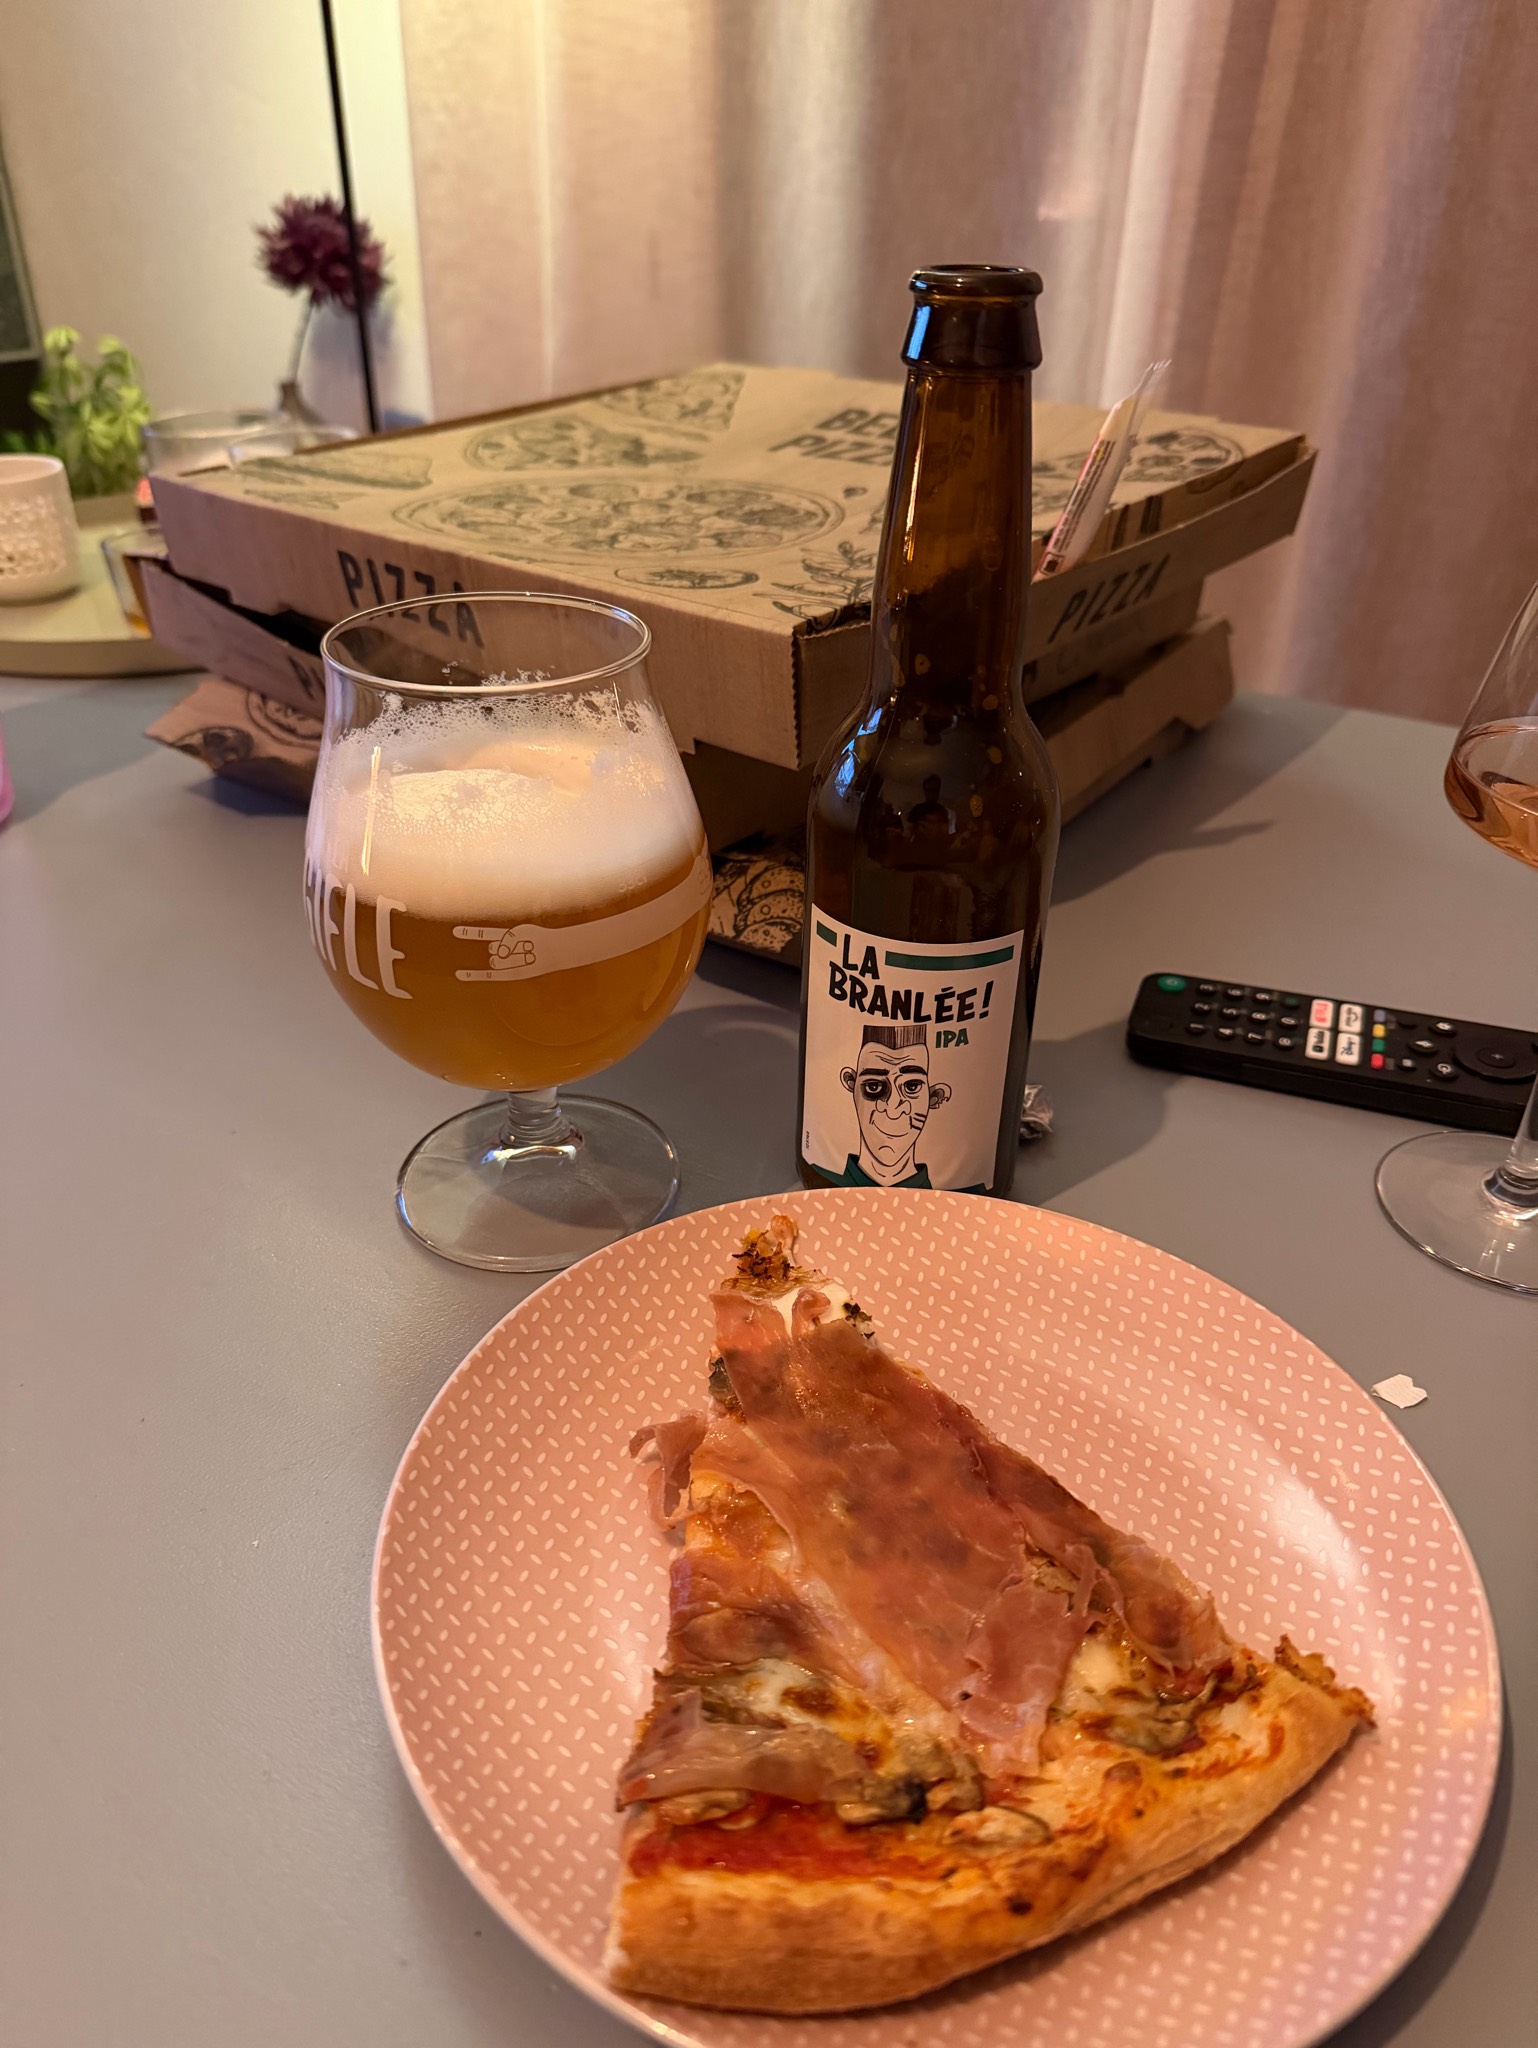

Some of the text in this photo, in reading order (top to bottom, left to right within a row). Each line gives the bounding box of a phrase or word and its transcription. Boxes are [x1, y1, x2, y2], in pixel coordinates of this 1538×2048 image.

[768, 434, 895, 466] PIZZ
[337, 550, 485, 649] PIZZA
[1047, 553, 1171, 644] PIZZA
[843, 934, 880, 980] LA
[936, 1028, 969, 1049] IPA
